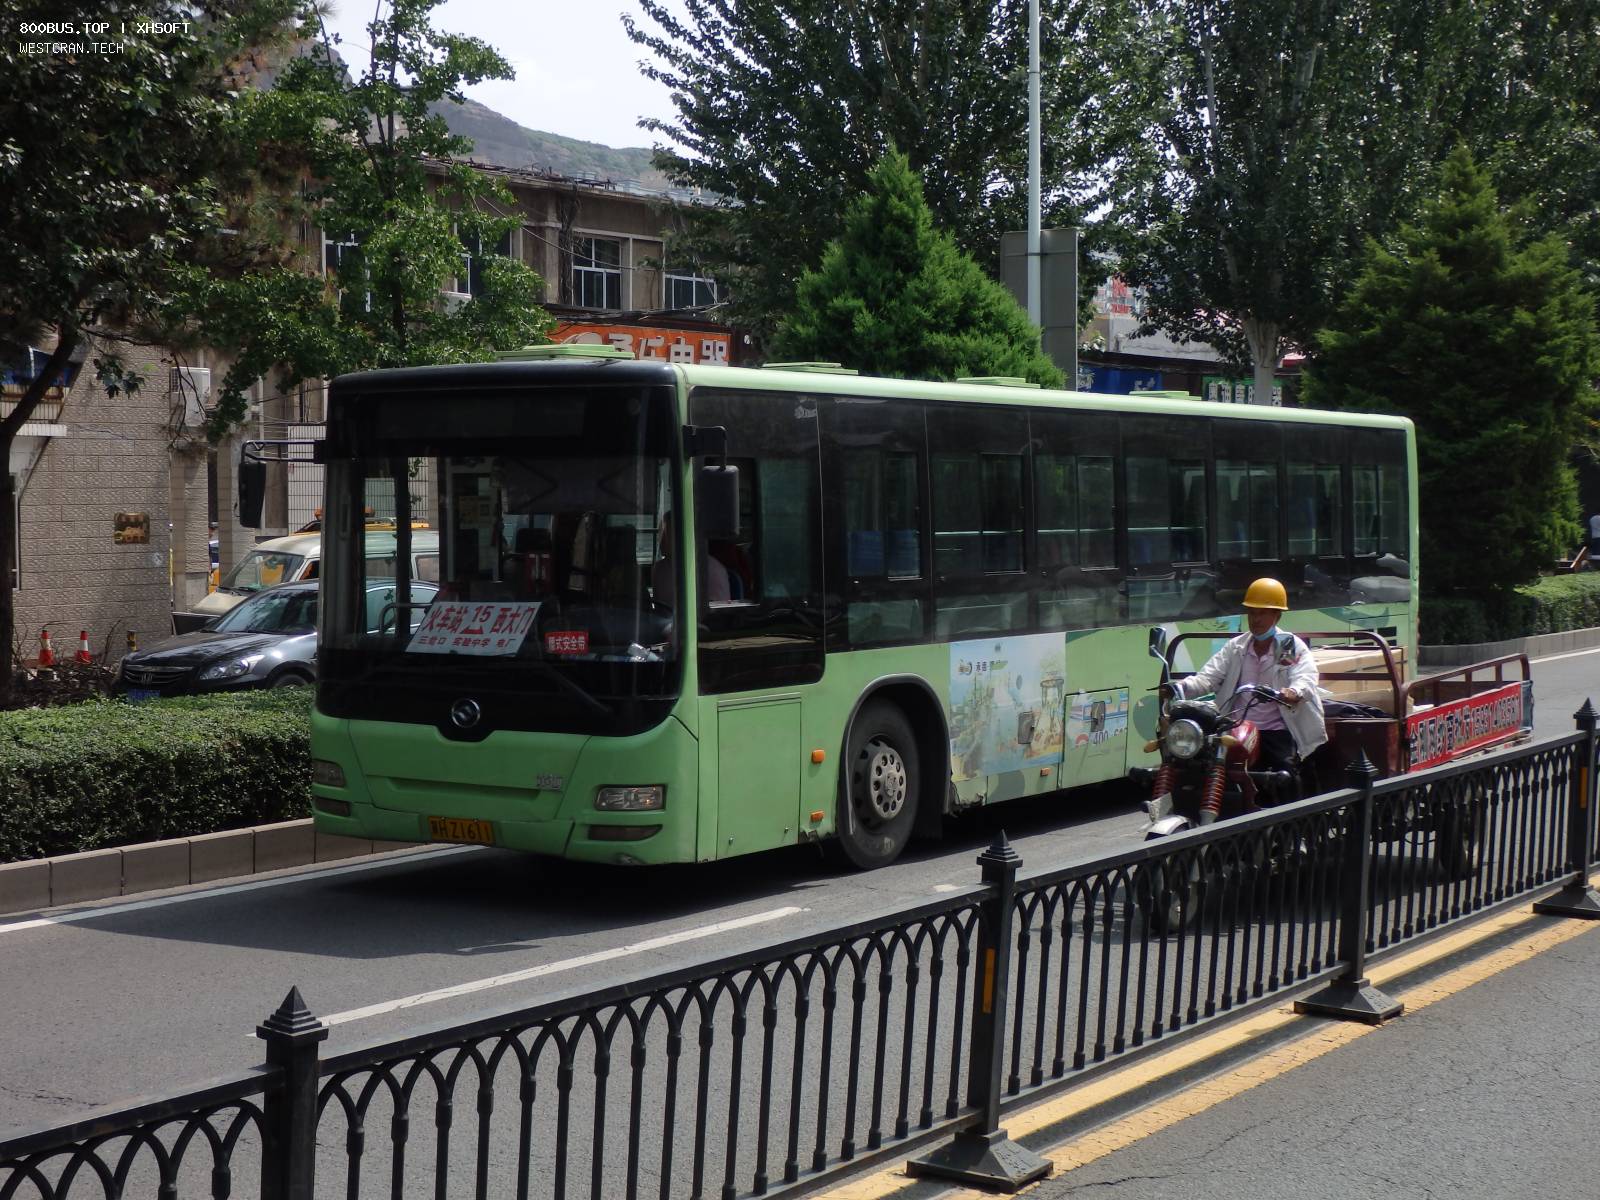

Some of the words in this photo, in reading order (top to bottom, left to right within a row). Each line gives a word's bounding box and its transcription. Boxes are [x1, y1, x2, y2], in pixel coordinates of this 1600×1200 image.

[422, 605, 469, 635] 火车站
[471, 605, 495, 623] 15
[490, 606, 536, 635] 西大门
